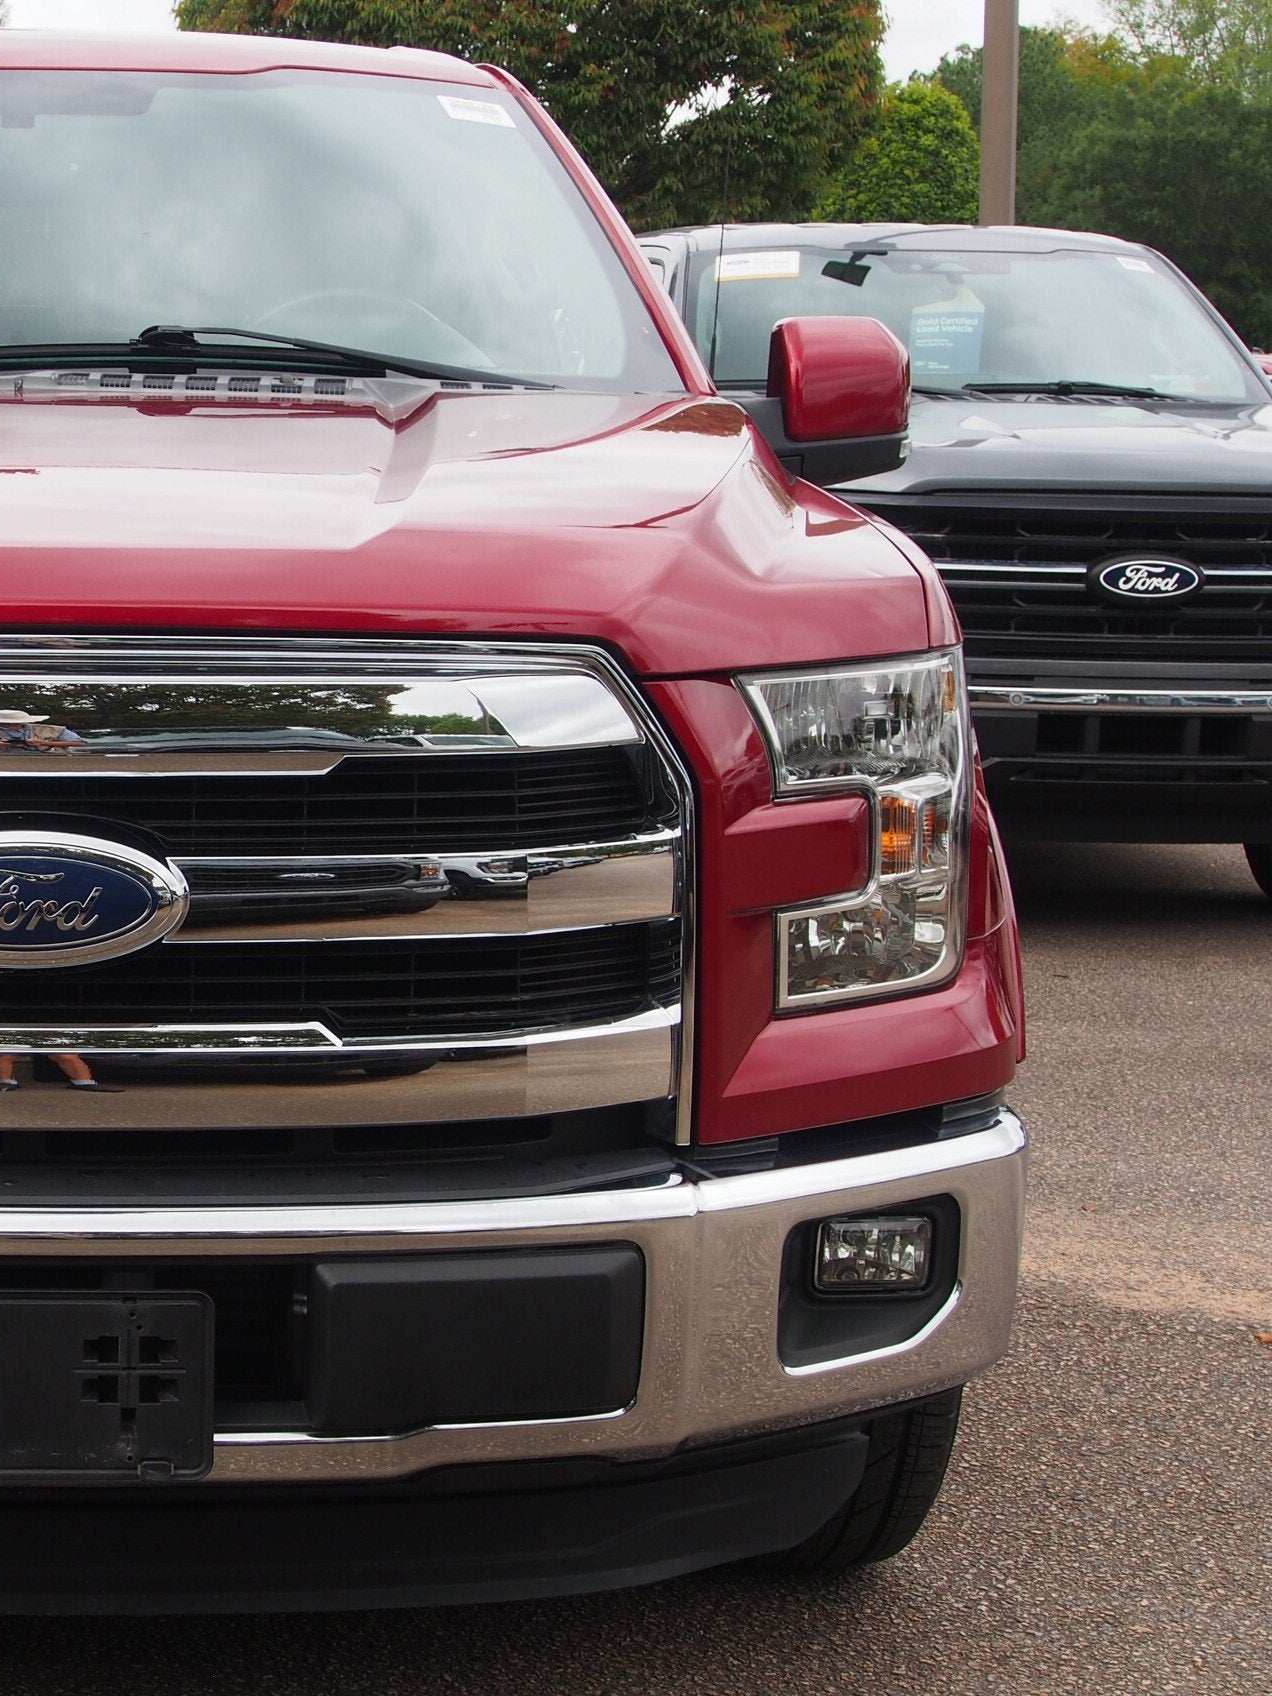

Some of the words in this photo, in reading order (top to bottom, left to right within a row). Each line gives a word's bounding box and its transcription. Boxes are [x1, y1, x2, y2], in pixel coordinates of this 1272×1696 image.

[940, 317, 978, 325] Certified
[916, 325, 940, 333] Used
[941, 325, 974, 333] Vehicle
[1118, 565, 1180, 591] Ford
